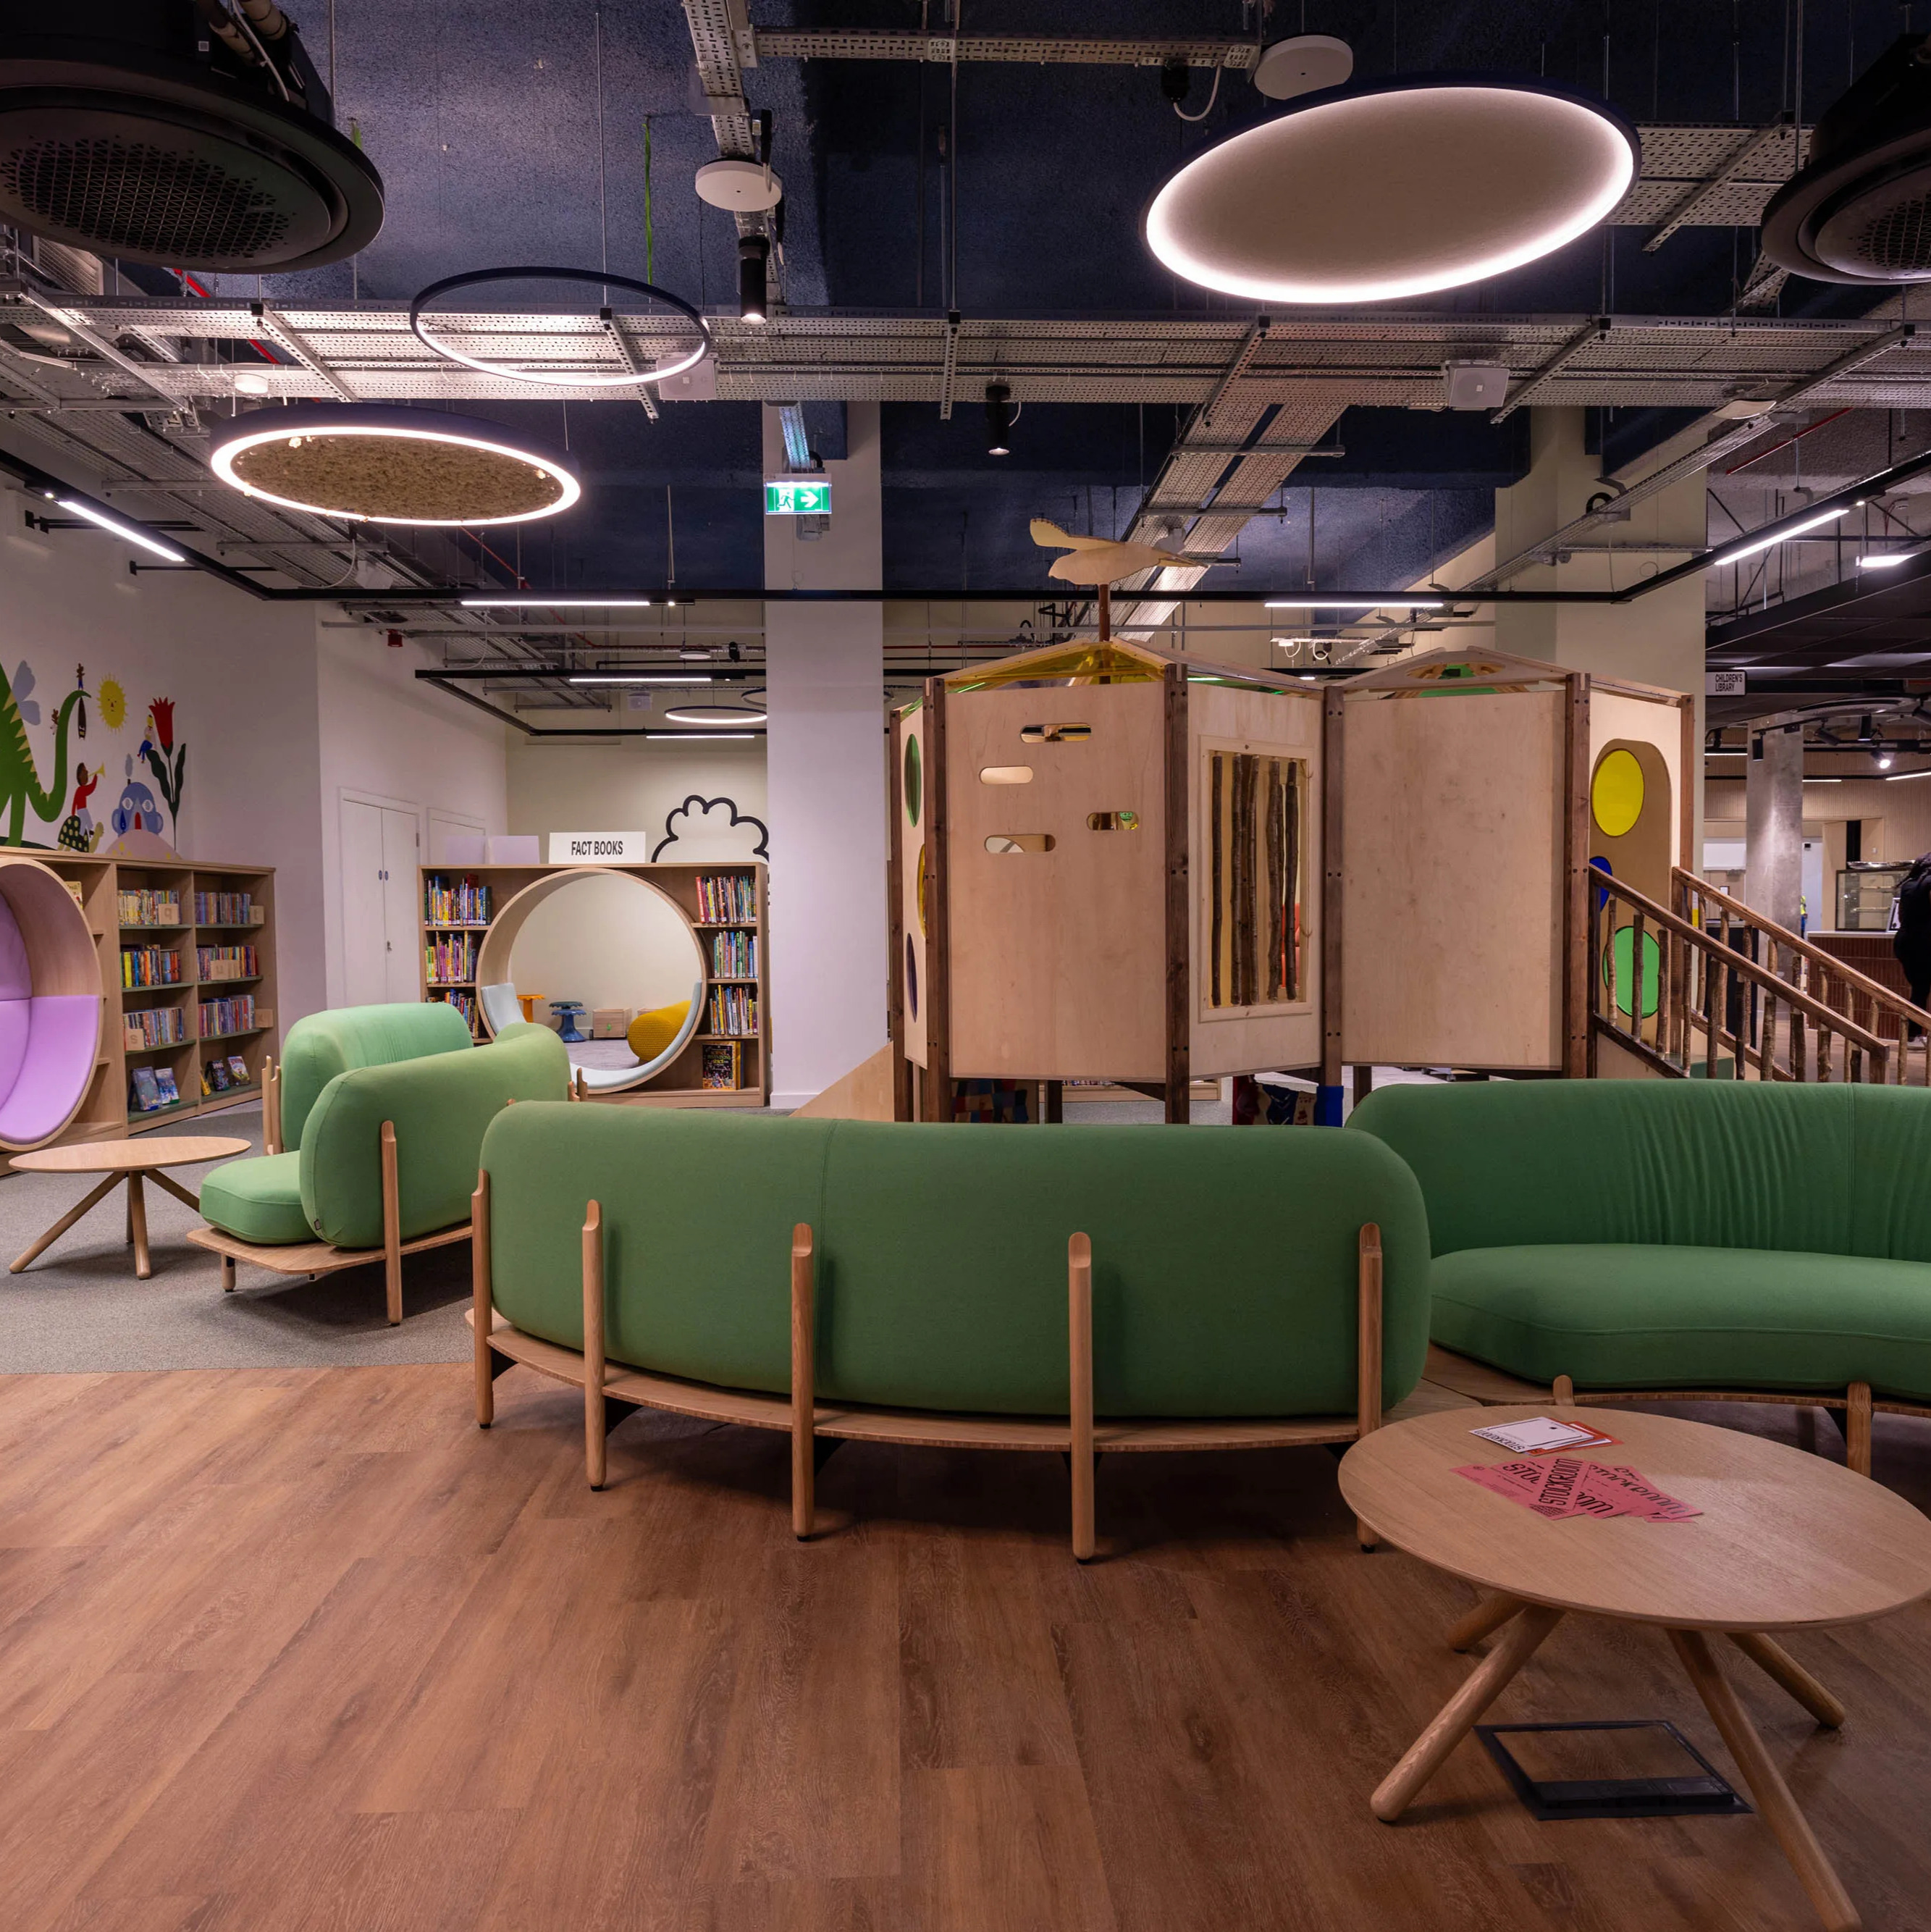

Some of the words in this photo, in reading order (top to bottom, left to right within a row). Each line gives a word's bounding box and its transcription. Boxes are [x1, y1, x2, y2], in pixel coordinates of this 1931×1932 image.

[1715, 673, 1743, 683] CHILDREN'S
[1715, 683, 1735, 692] LIBRARY
[571, 841, 592, 855] FACT
[594, 840, 623, 855] BOOKS
[1539, 1458, 1583, 1506] STOCKROOM
